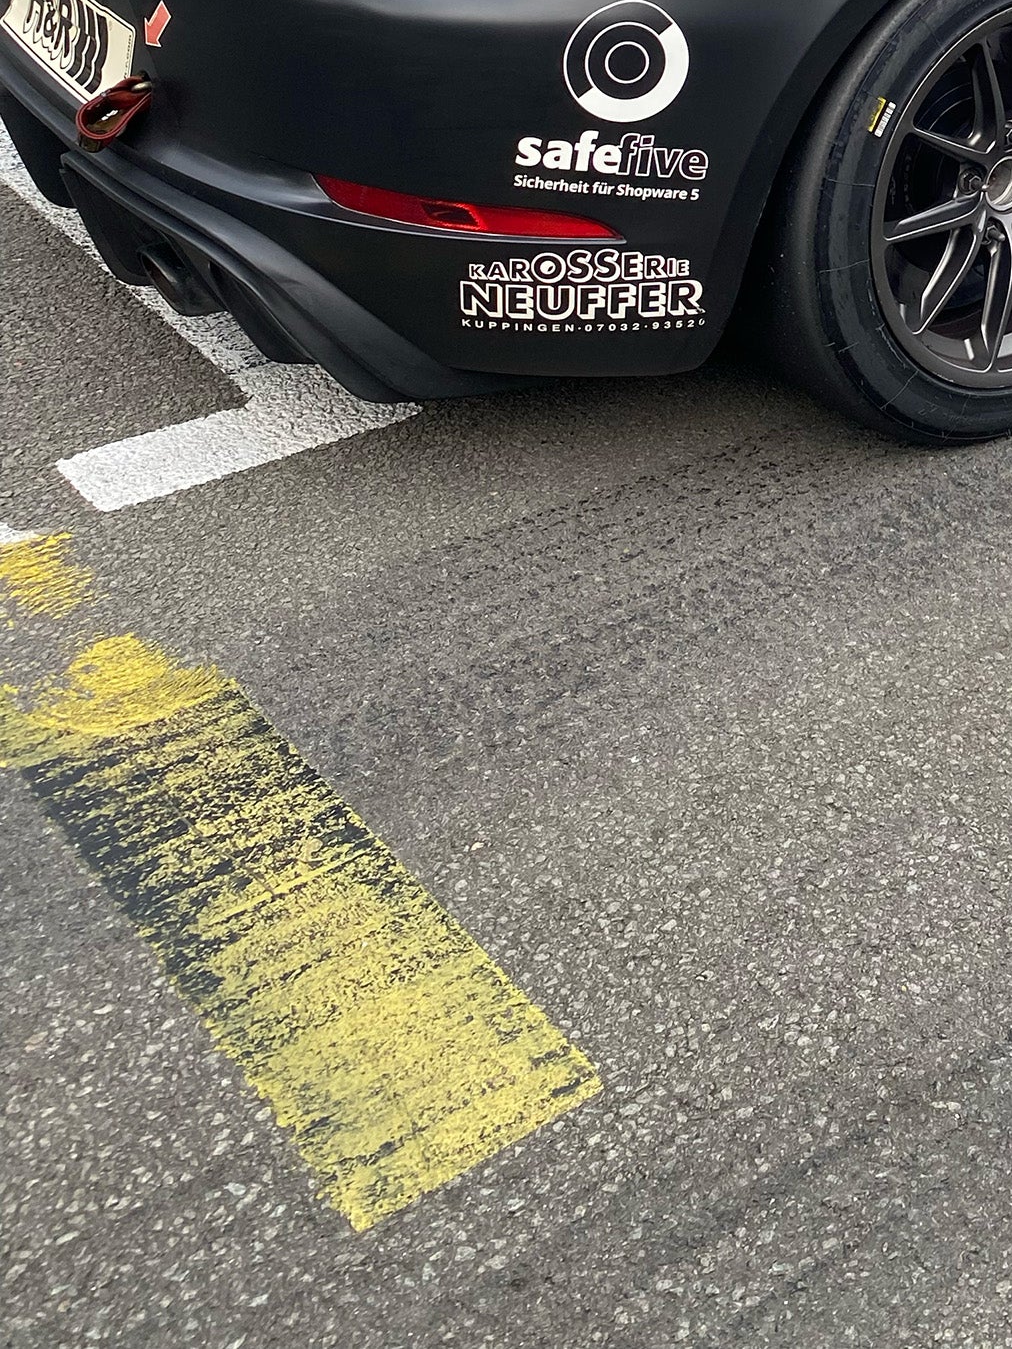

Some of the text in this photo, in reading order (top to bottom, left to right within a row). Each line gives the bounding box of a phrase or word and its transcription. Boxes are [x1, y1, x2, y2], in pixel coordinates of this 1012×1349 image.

[514, 130, 709, 181] safefive
[513, 174, 700, 201] Sicherheit für Shopware 5
[468, 248, 690, 284] KAROSSERIE
[460, 279, 706, 321] NEUFFER
